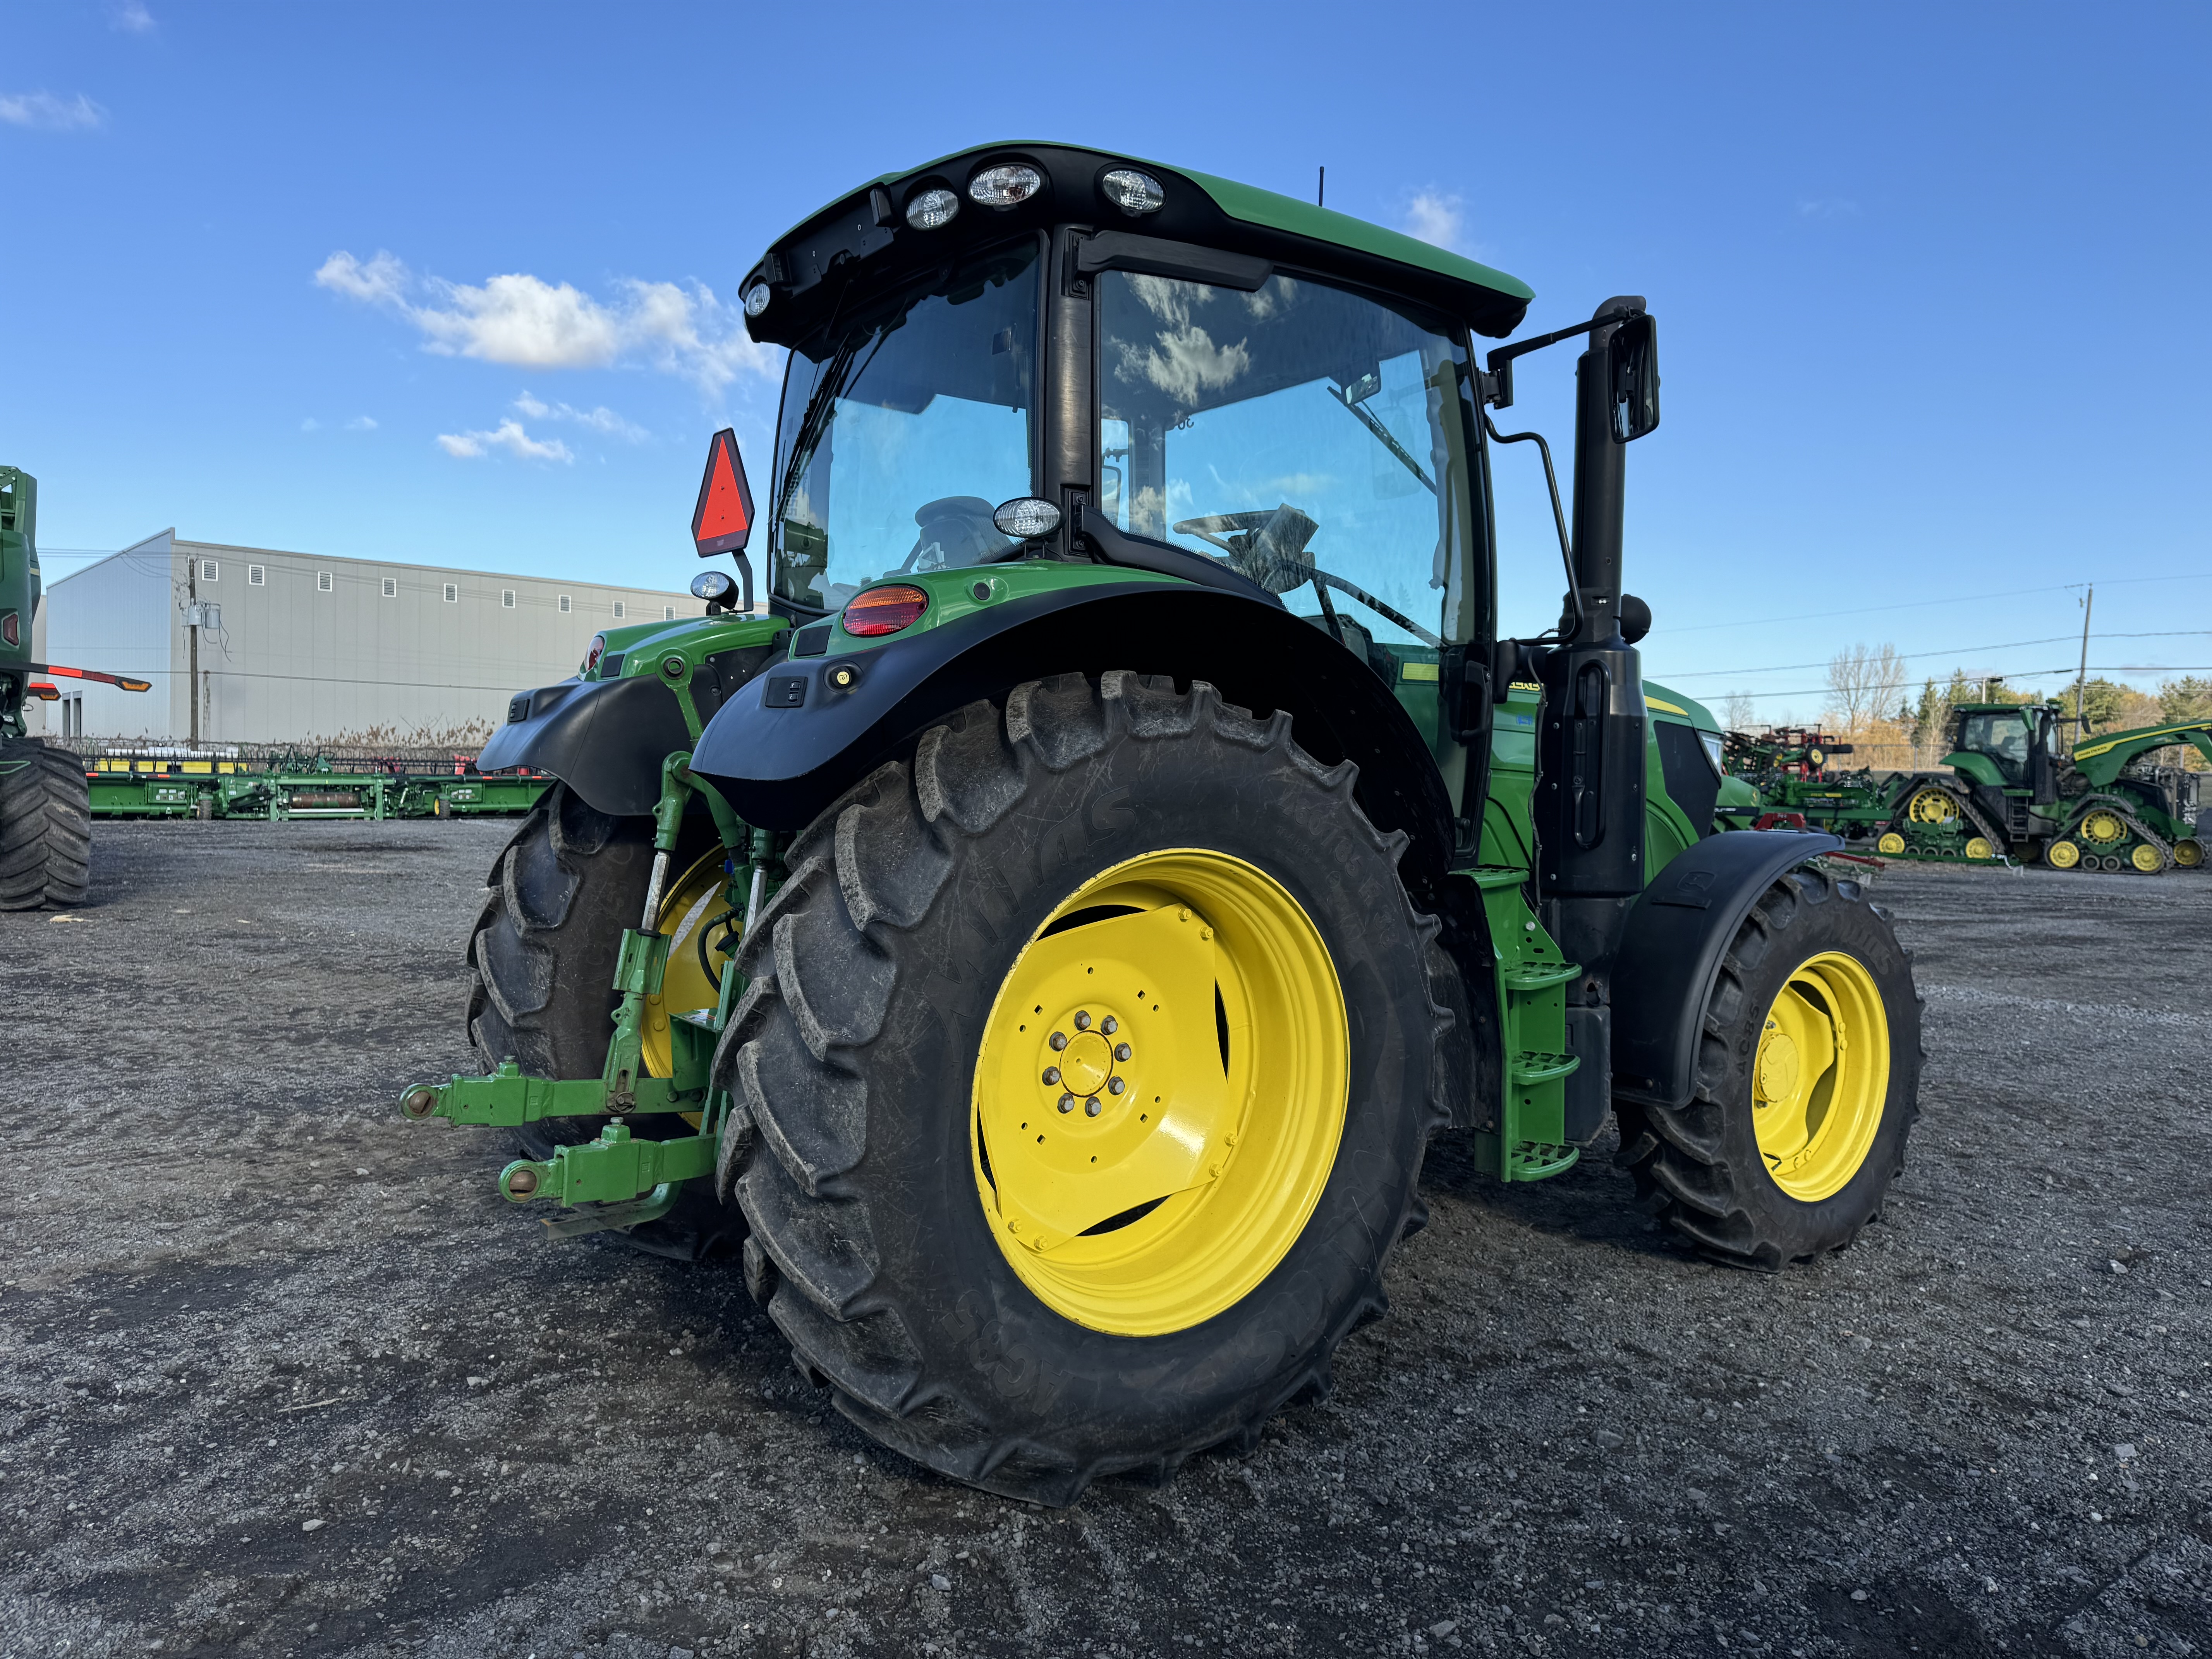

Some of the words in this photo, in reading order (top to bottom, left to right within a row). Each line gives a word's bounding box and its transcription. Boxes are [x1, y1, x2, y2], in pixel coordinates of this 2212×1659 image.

[924, 785, 1136, 1063] Mitas
[1278, 790, 1362, 878] 460/85
[1358, 874, 1385, 908] R
[1374, 904, 1400, 949] 38
[1736, 1002, 1760, 1077] AC85
[1236, 1112, 1401, 1374] Mitas
[940, 1290, 1074, 1417] AC85
